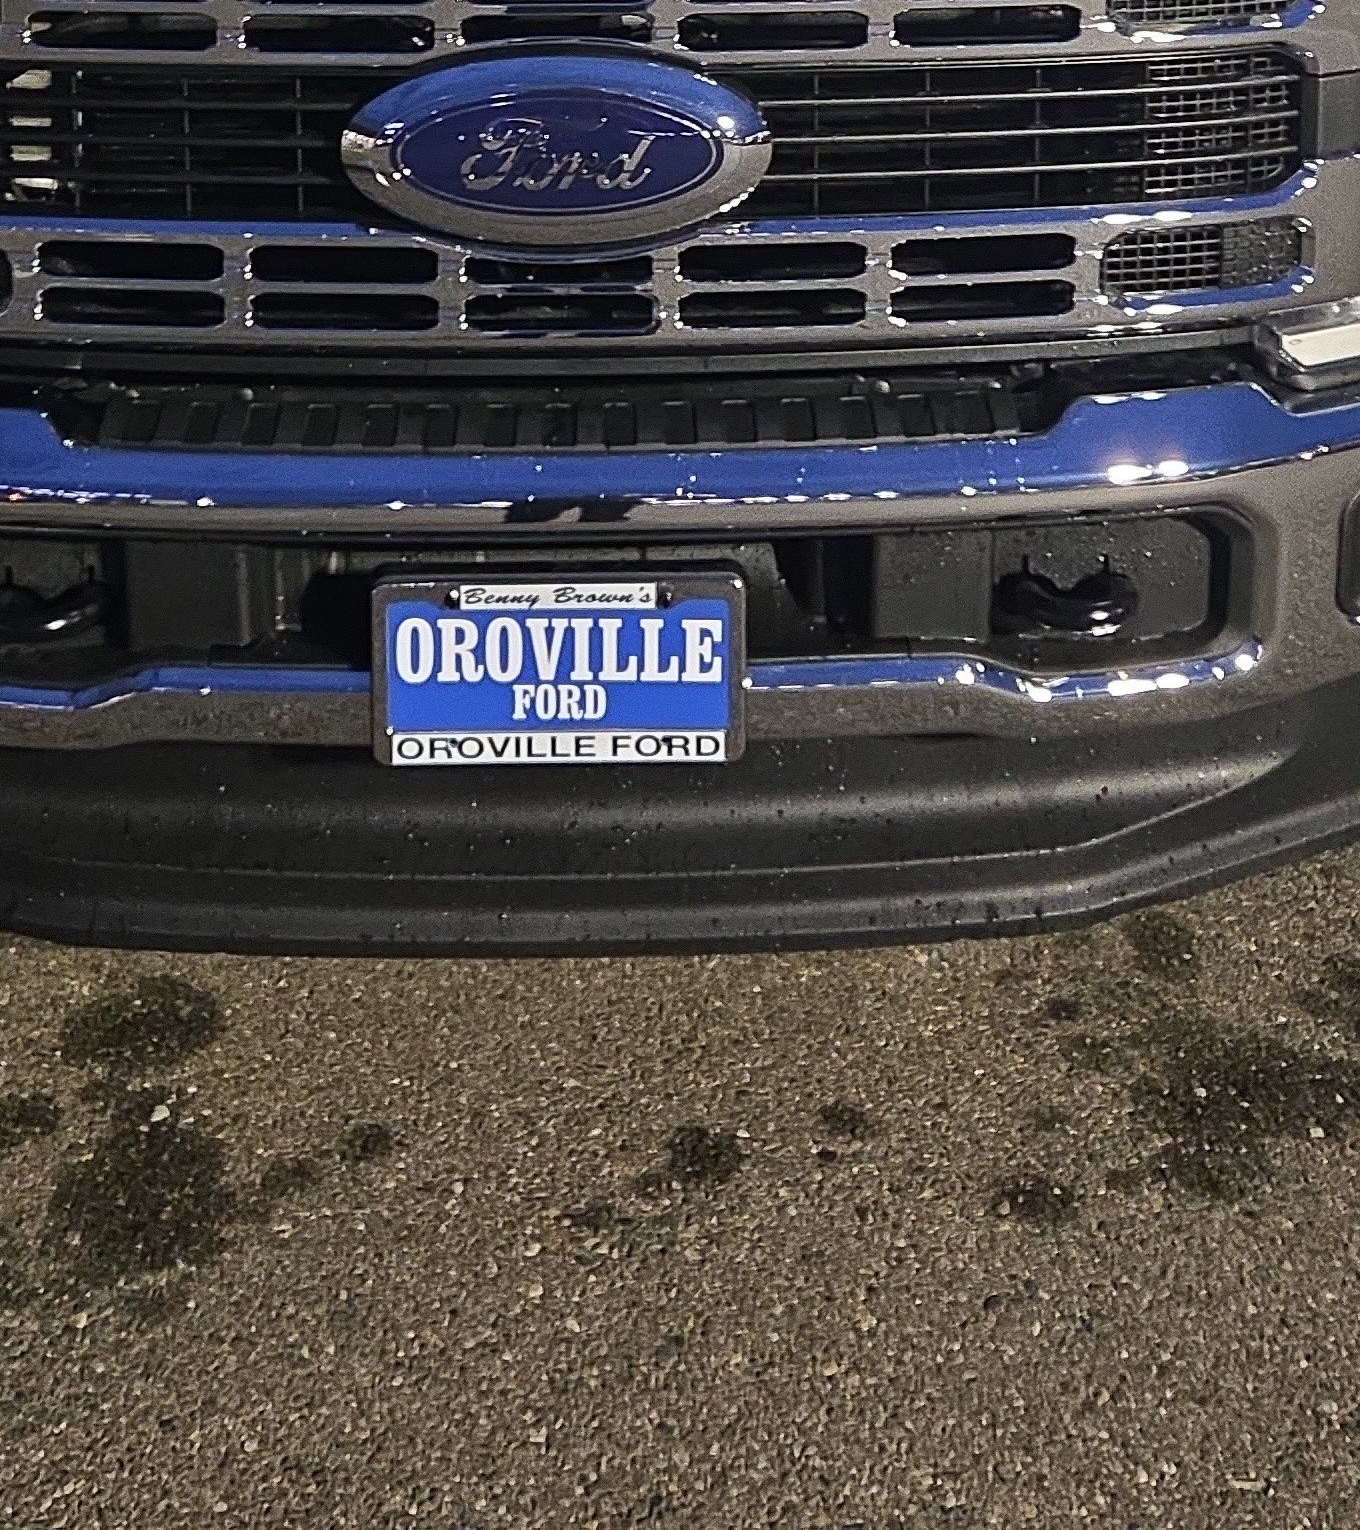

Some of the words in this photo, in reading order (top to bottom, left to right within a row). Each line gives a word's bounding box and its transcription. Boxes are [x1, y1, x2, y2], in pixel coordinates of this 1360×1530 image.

[461, 117, 657, 192] Ford
[463, 587, 542, 608] Benny
[552, 585, 654, 605] Brown's
[395, 617, 724, 684] OROVILLE
[511, 684, 608, 721] FORD
[396, 735, 596, 760] OROVILLE
[611, 734, 722, 758] FORD
